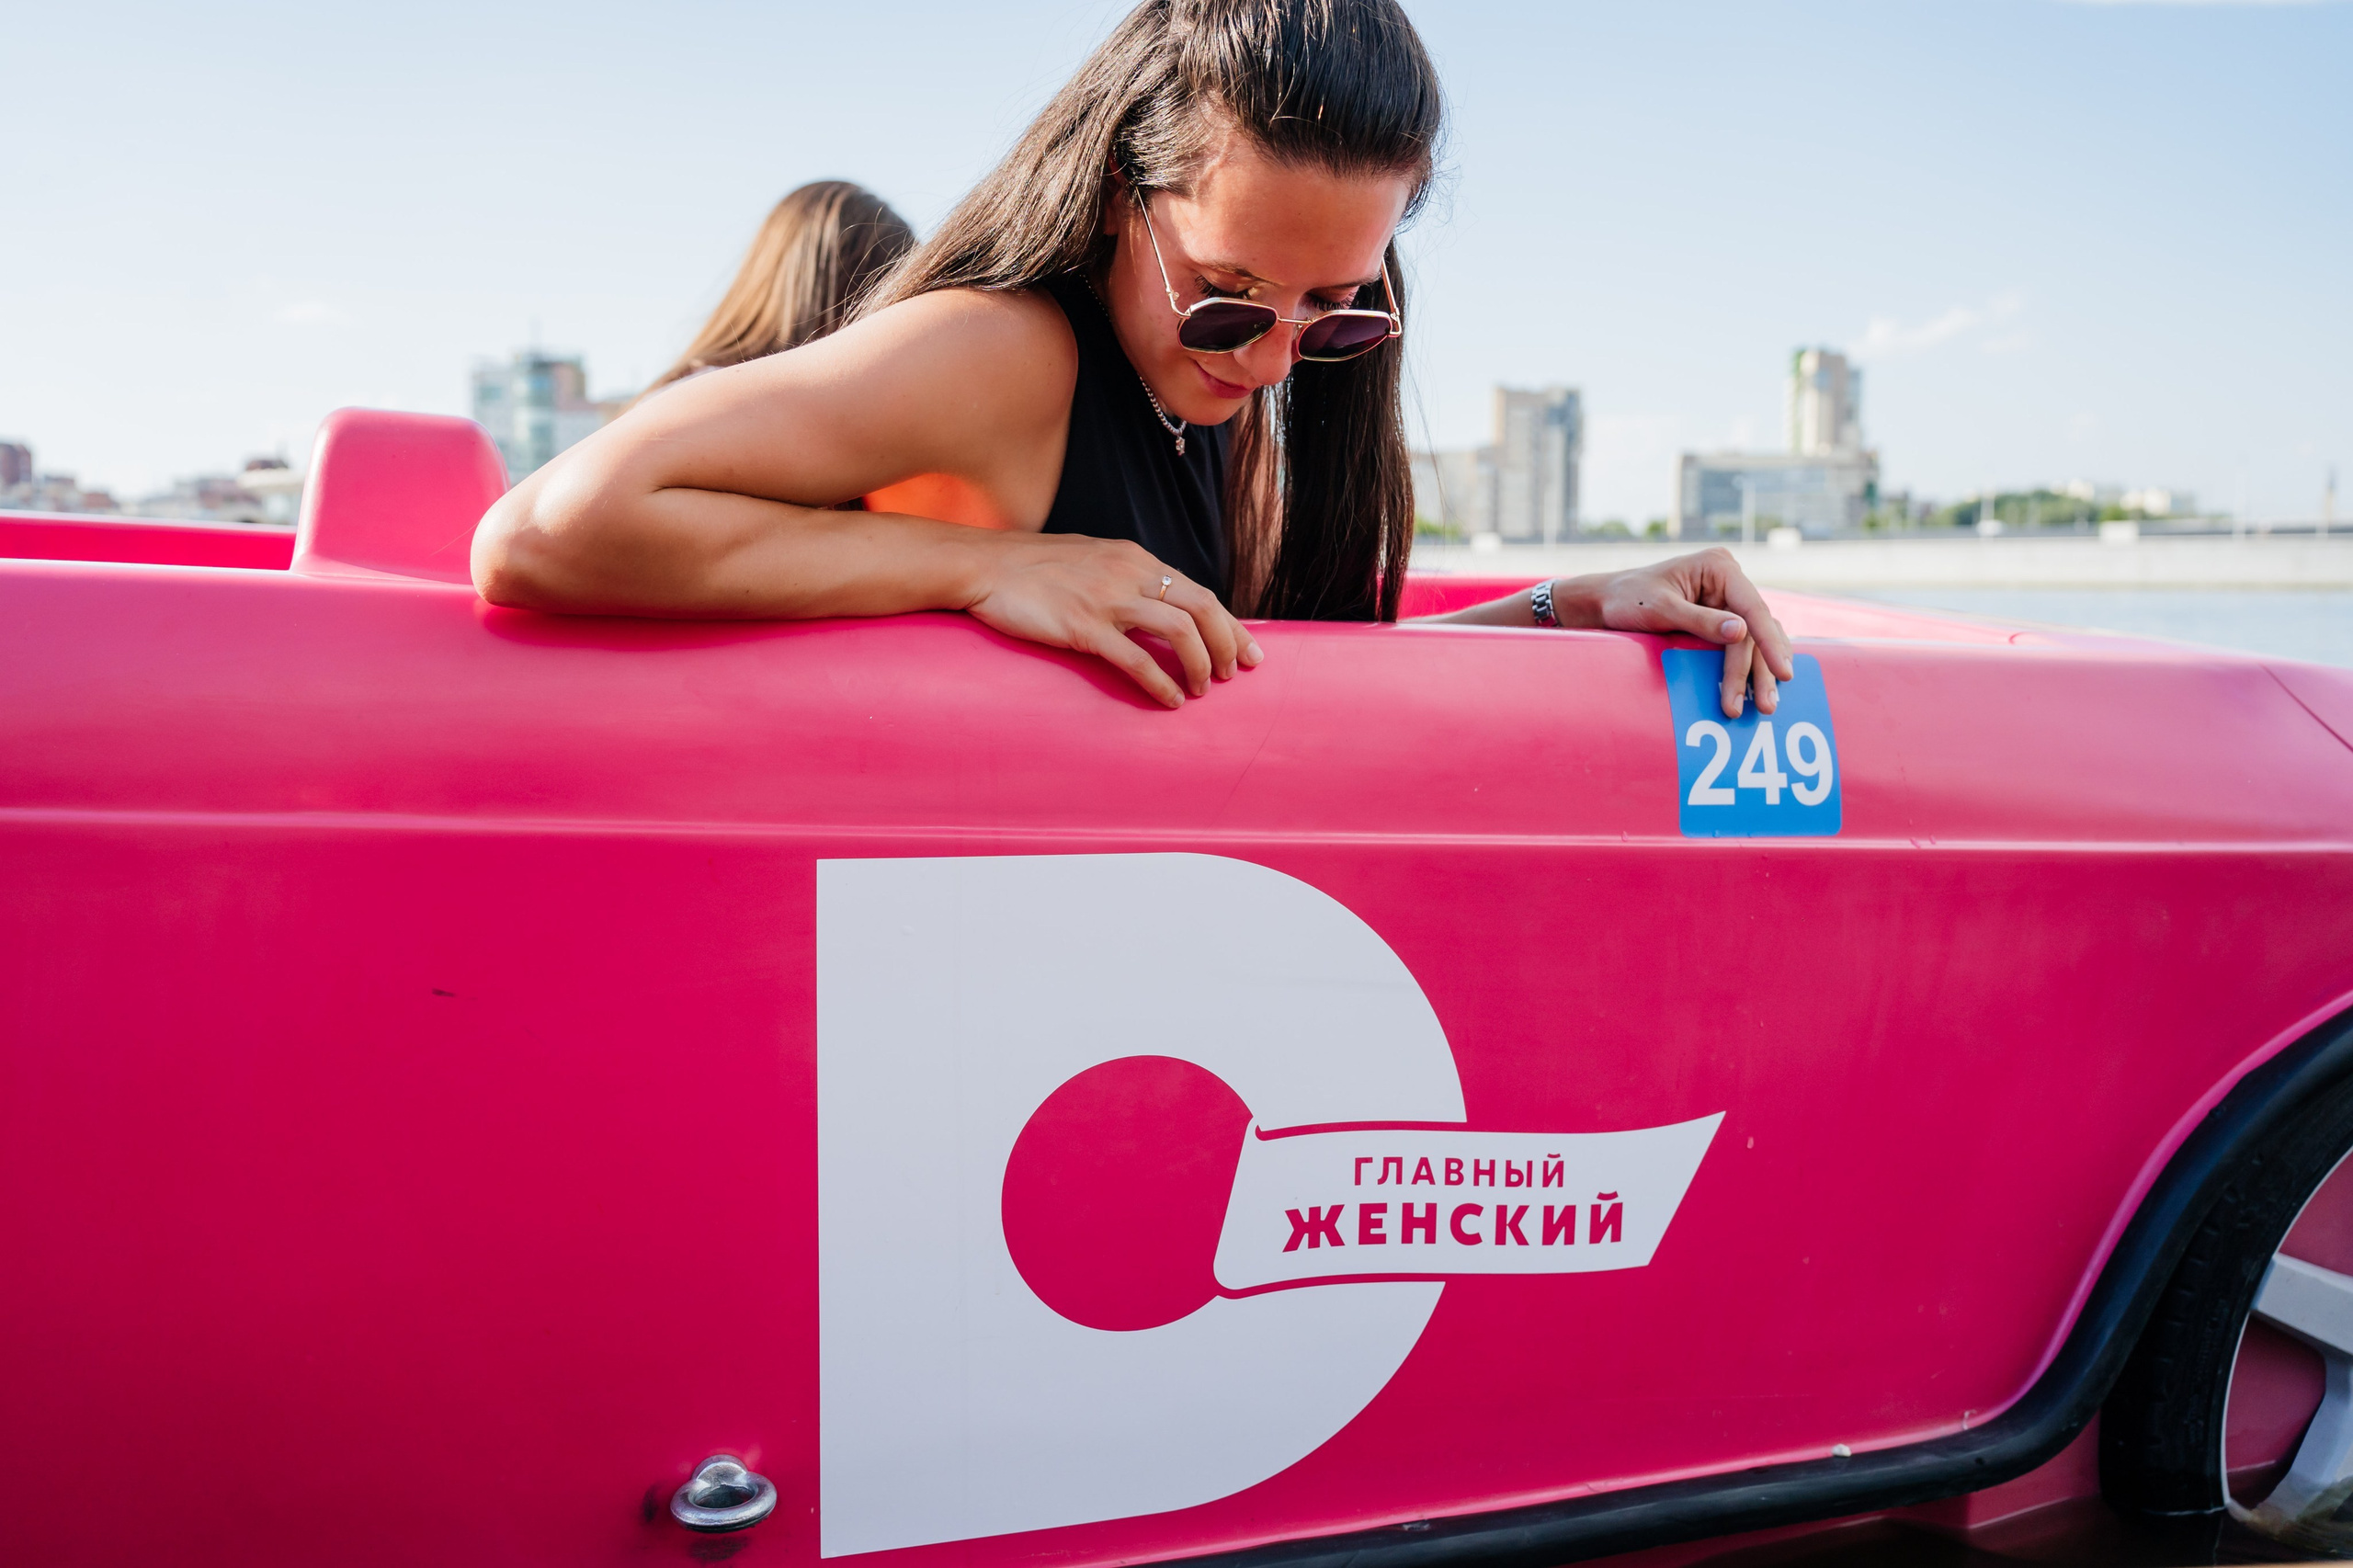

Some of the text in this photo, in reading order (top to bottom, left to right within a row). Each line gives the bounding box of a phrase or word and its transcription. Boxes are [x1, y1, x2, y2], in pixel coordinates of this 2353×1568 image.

[1686, 720, 1834, 806] 249
[1354, 1153, 1564, 1188] ГЛАВНЫЙ
[1282, 1191, 1623, 1253] ЖЕНСКИЙ
